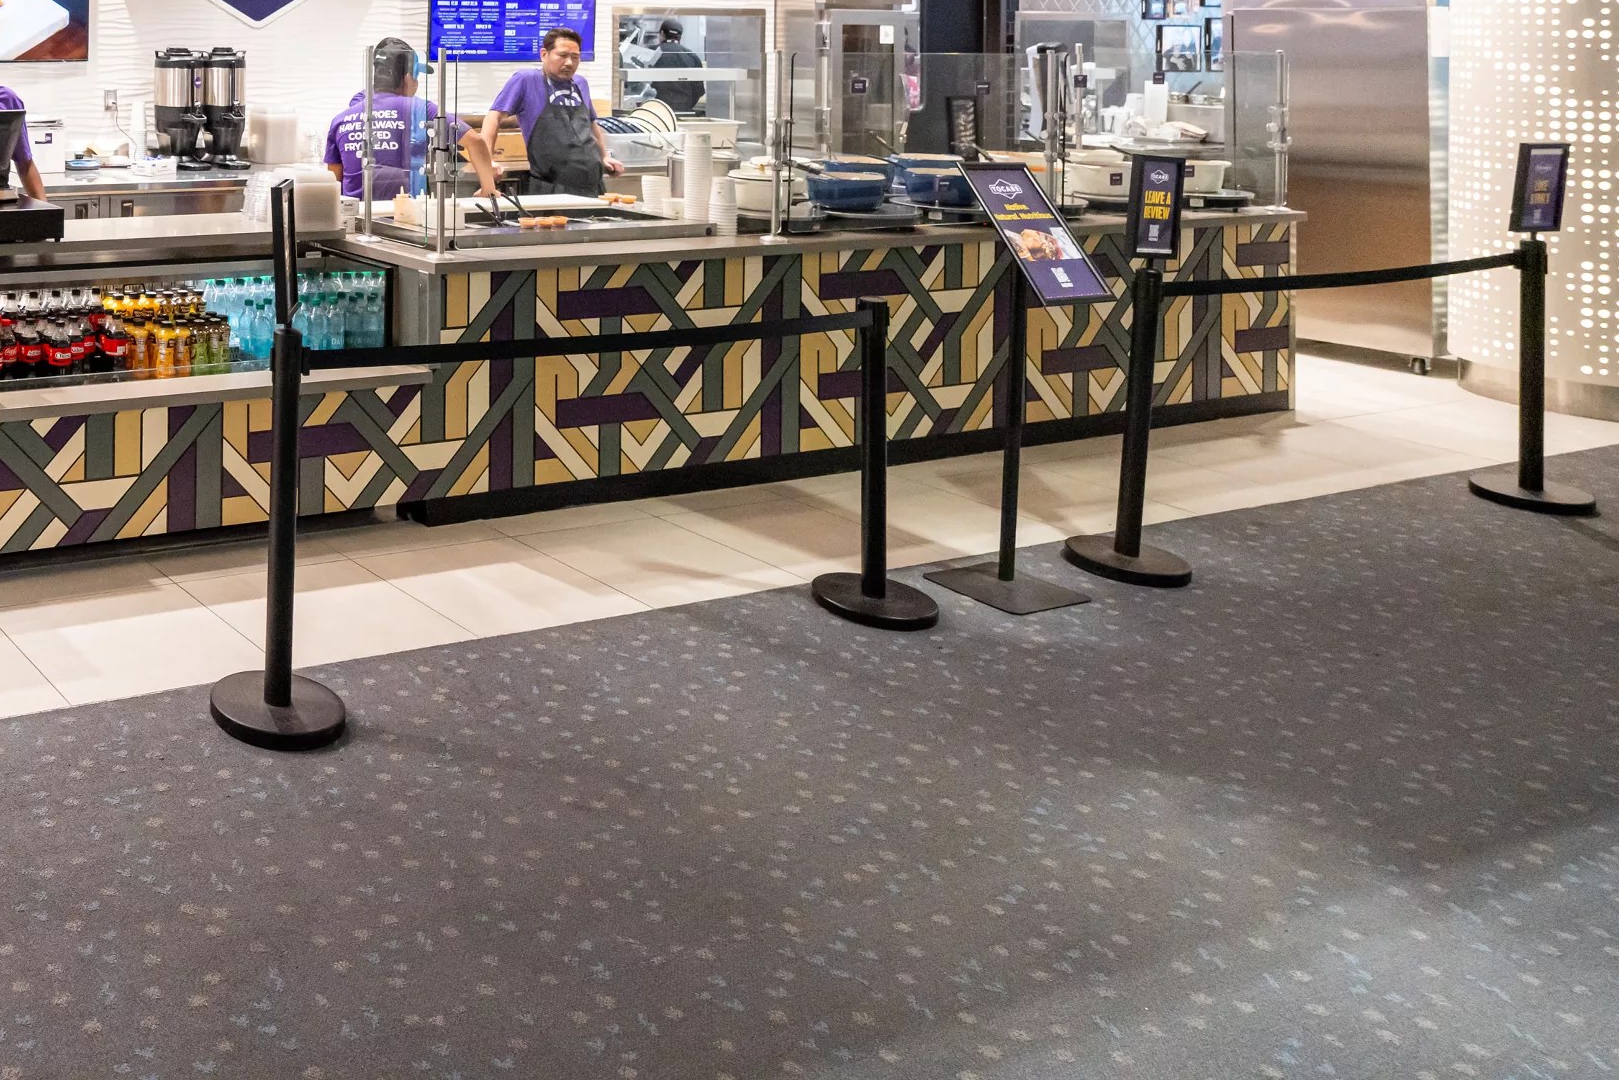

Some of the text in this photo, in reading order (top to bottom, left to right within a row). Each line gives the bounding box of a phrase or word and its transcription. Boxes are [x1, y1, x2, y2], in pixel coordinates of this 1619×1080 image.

[344, 110, 398, 122] MY HROES
[339, 122, 362, 133] HAVE
[991, 185, 1020, 193] TOCABE
[1145, 190, 1171, 205] LEAVE A
[1004, 203, 1030, 211] Native.
[1144, 206, 1170, 220] REVIEW
